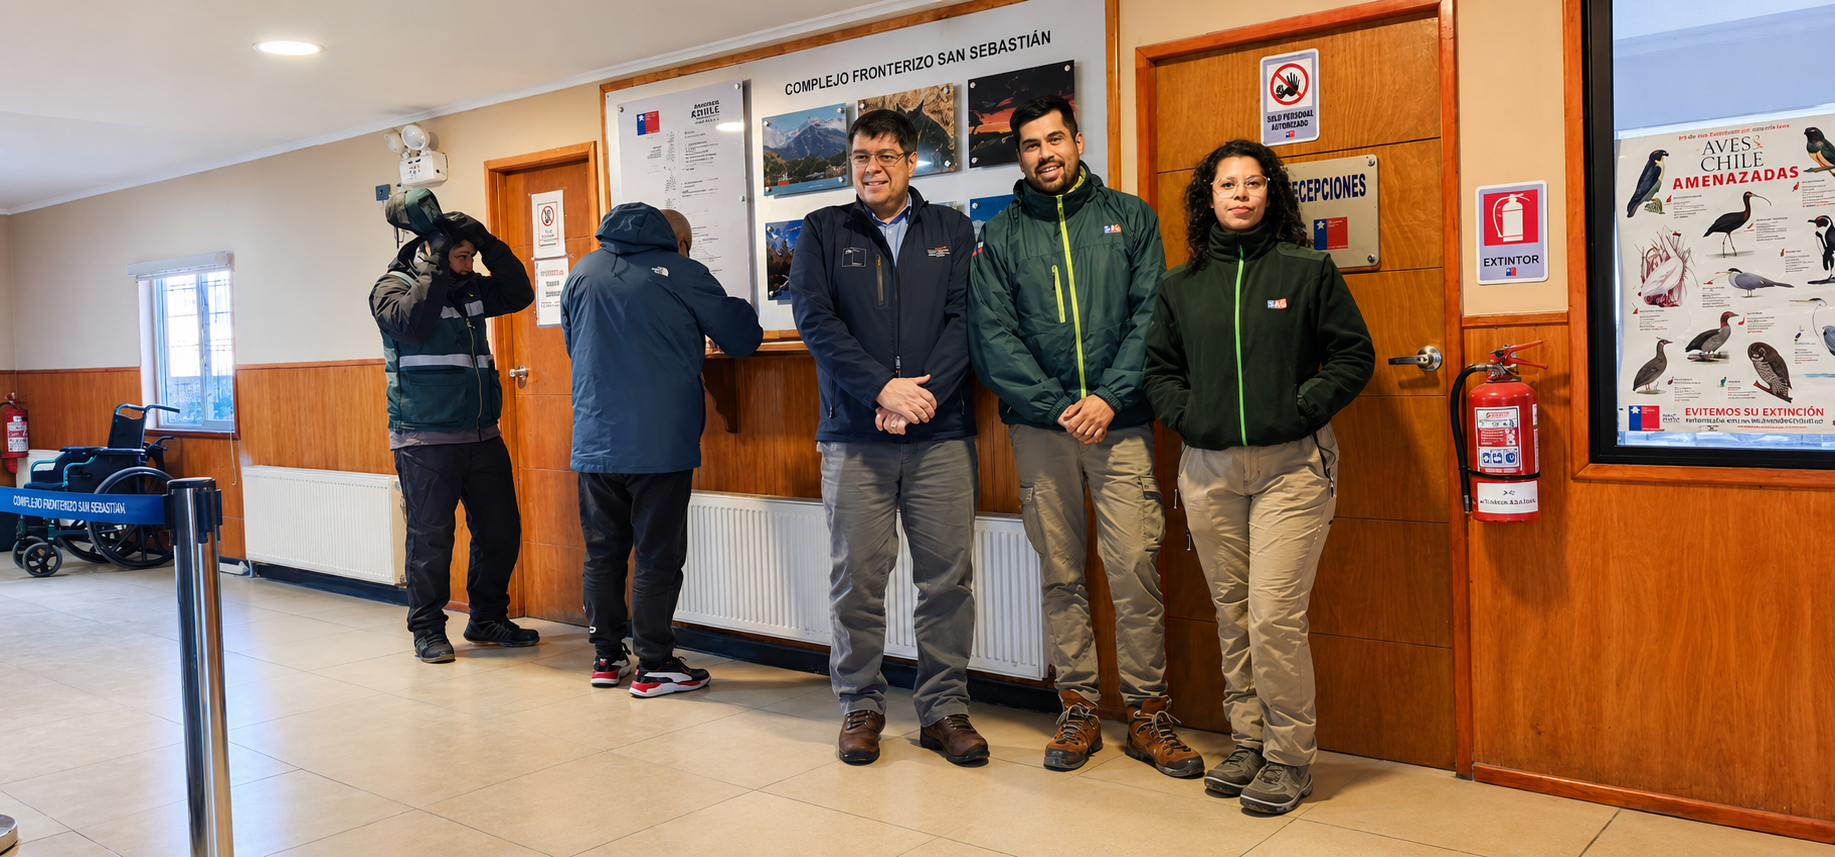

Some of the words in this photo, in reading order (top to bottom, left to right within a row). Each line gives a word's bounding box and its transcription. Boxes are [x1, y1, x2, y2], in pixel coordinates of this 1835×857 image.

[785, 72, 849, 96] COMPLEJO
[852, 54, 934, 83] FRONTERIZO
[937, 48, 965, 67] SAN
[970, 30, 1051, 60] SEBASTIÁN
[1701, 151, 1764, 172] CHILE
[1291, 173, 1366, 203] ECEPCIONES
[1673, 165, 1799, 190] AMENAZADAS
[1483, 254, 1540, 268] EXTINTOR
[1685, 407, 1741, 417] EVITEMOS
[1743, 407, 1759, 417] SU
[1762, 405, 1824, 417] EXTINCIÓN
